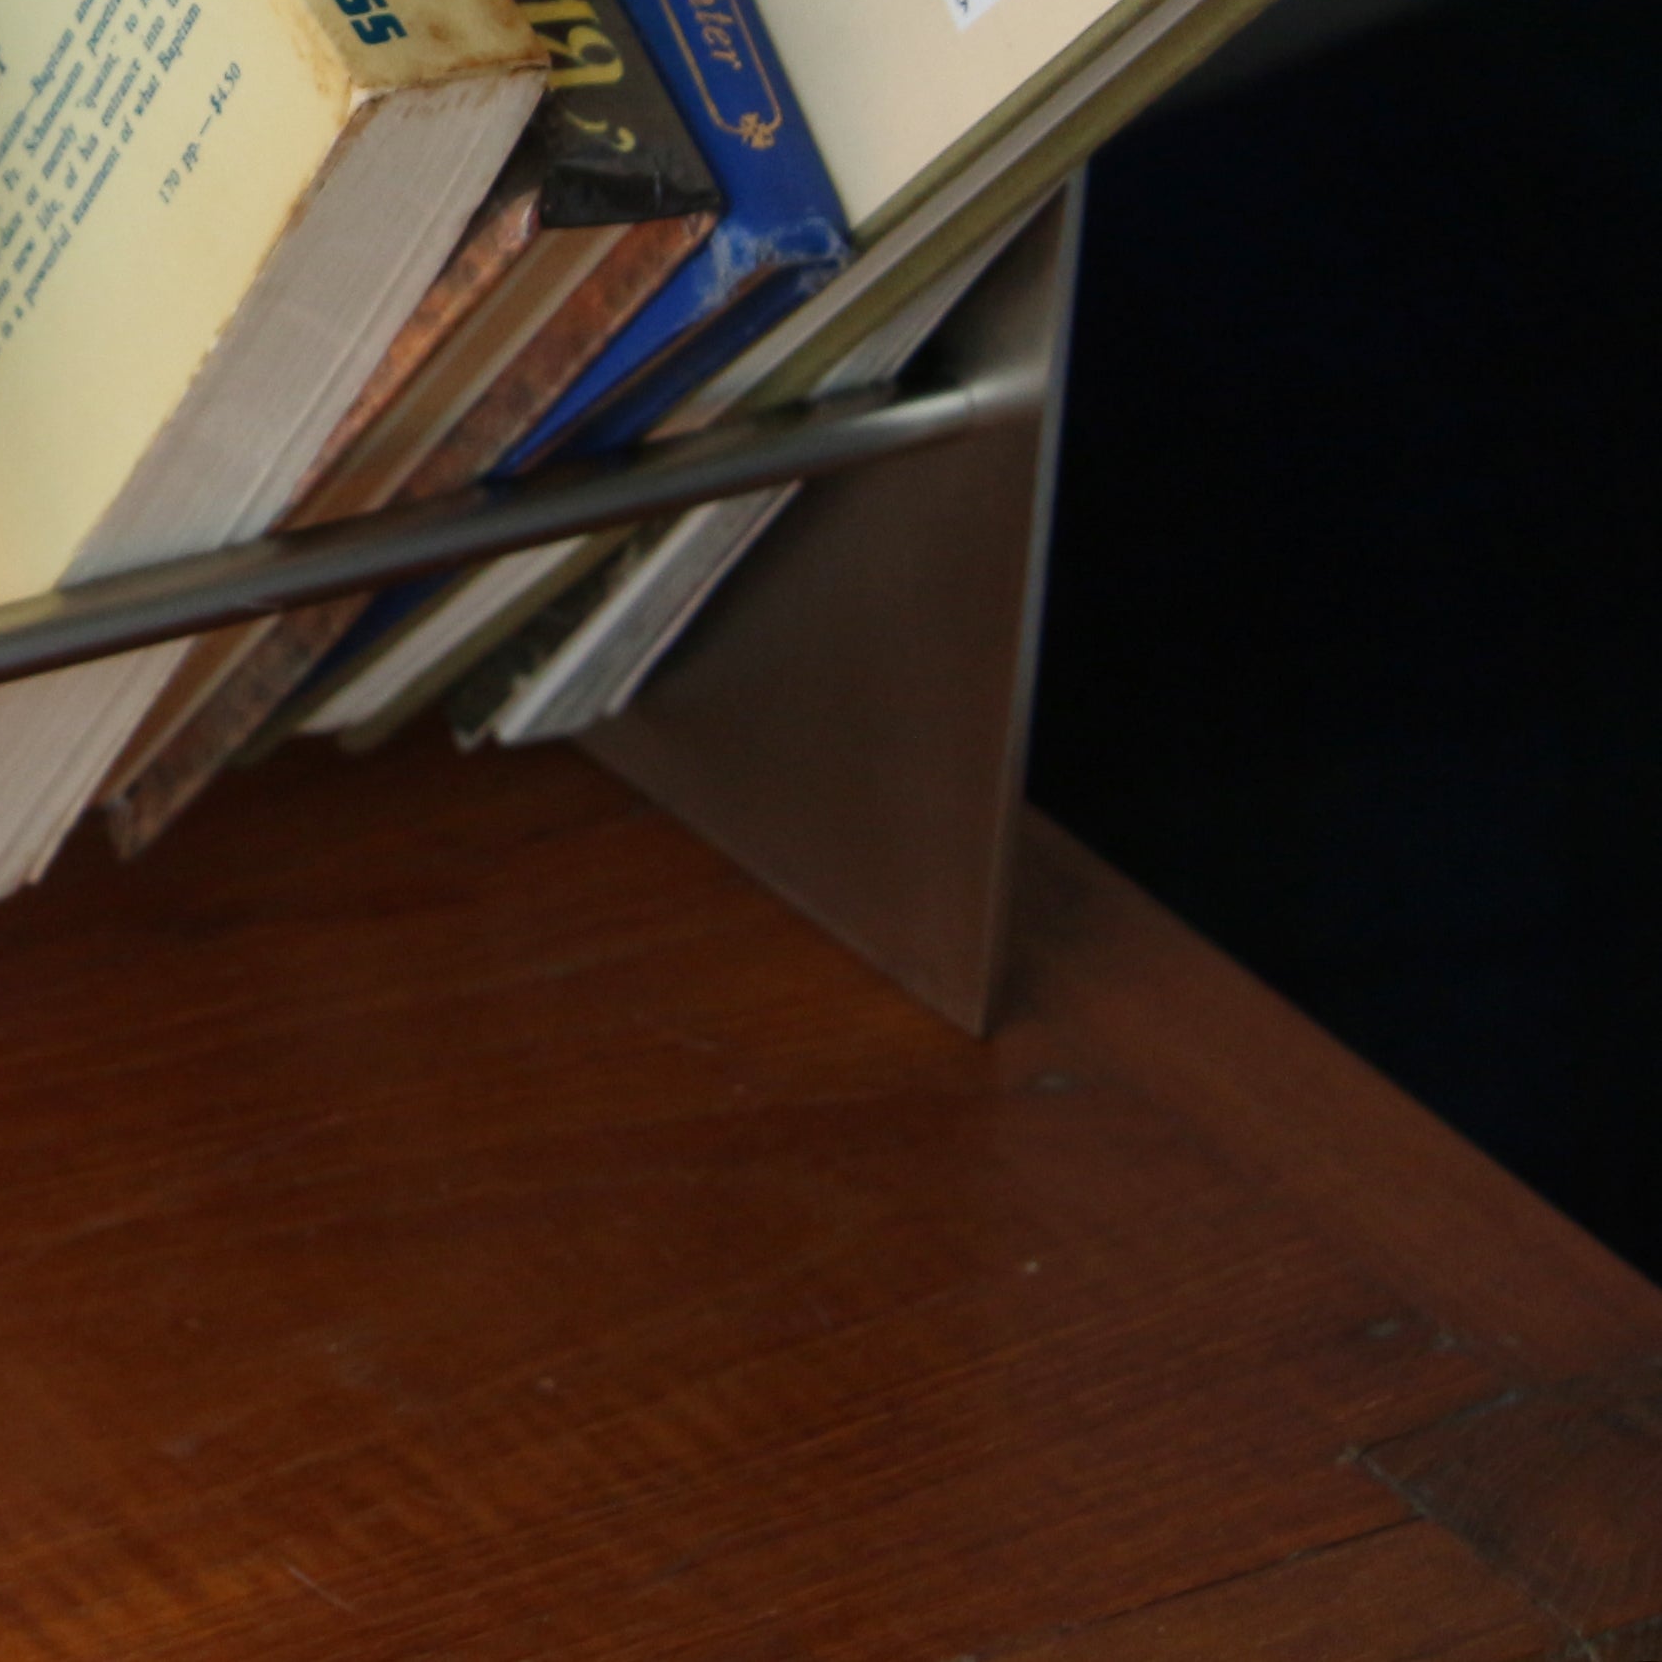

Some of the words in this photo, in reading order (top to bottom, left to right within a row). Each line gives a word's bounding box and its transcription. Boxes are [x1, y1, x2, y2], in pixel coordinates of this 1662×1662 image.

[21, 58, 85, 158] Schmemann
[22, 221, 72, 308] powerful
[69, 142, 121, 227] statement
[119, 116, 135, 145] of
[132, 71, 161, 119] what
[156, 0, 203, 74] Baptism
[40, 121, 77, 182] merely
[122, 10, 139, 36] to
[62, 162, 79, 191] of
[77, 130, 100, 163] his
[99, 55, 143, 130] entrance
[141, 12, 167, 54] into
[180, 138, 201, 173] pp.
